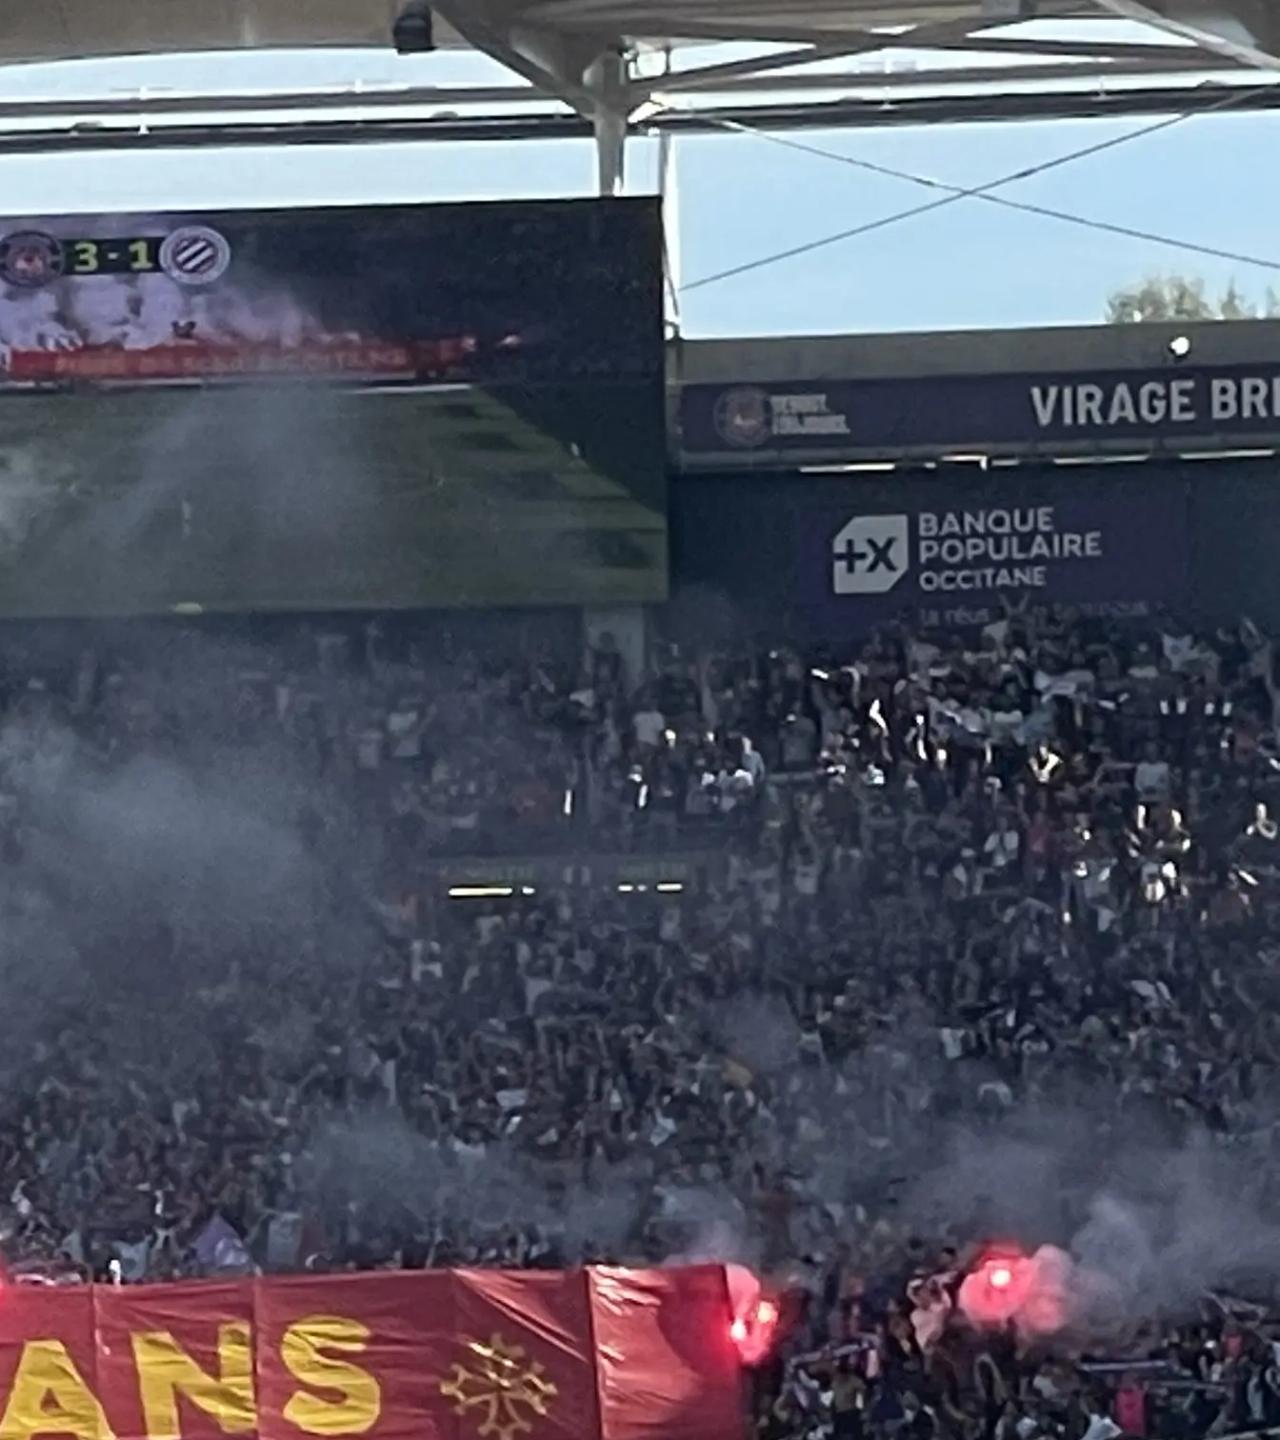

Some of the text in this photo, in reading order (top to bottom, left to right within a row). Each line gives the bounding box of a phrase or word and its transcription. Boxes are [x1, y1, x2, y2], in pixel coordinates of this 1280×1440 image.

[73, 242, 98, 273] 3
[128, 241, 154, 270] 1
[1030, 376, 1280, 426] VIRAGE BRI
[918, 506, 1054, 537] BANQUE
[918, 530, 1102, 565] POPULAIRE
[918, 566, 1047, 592] OCCITANE
